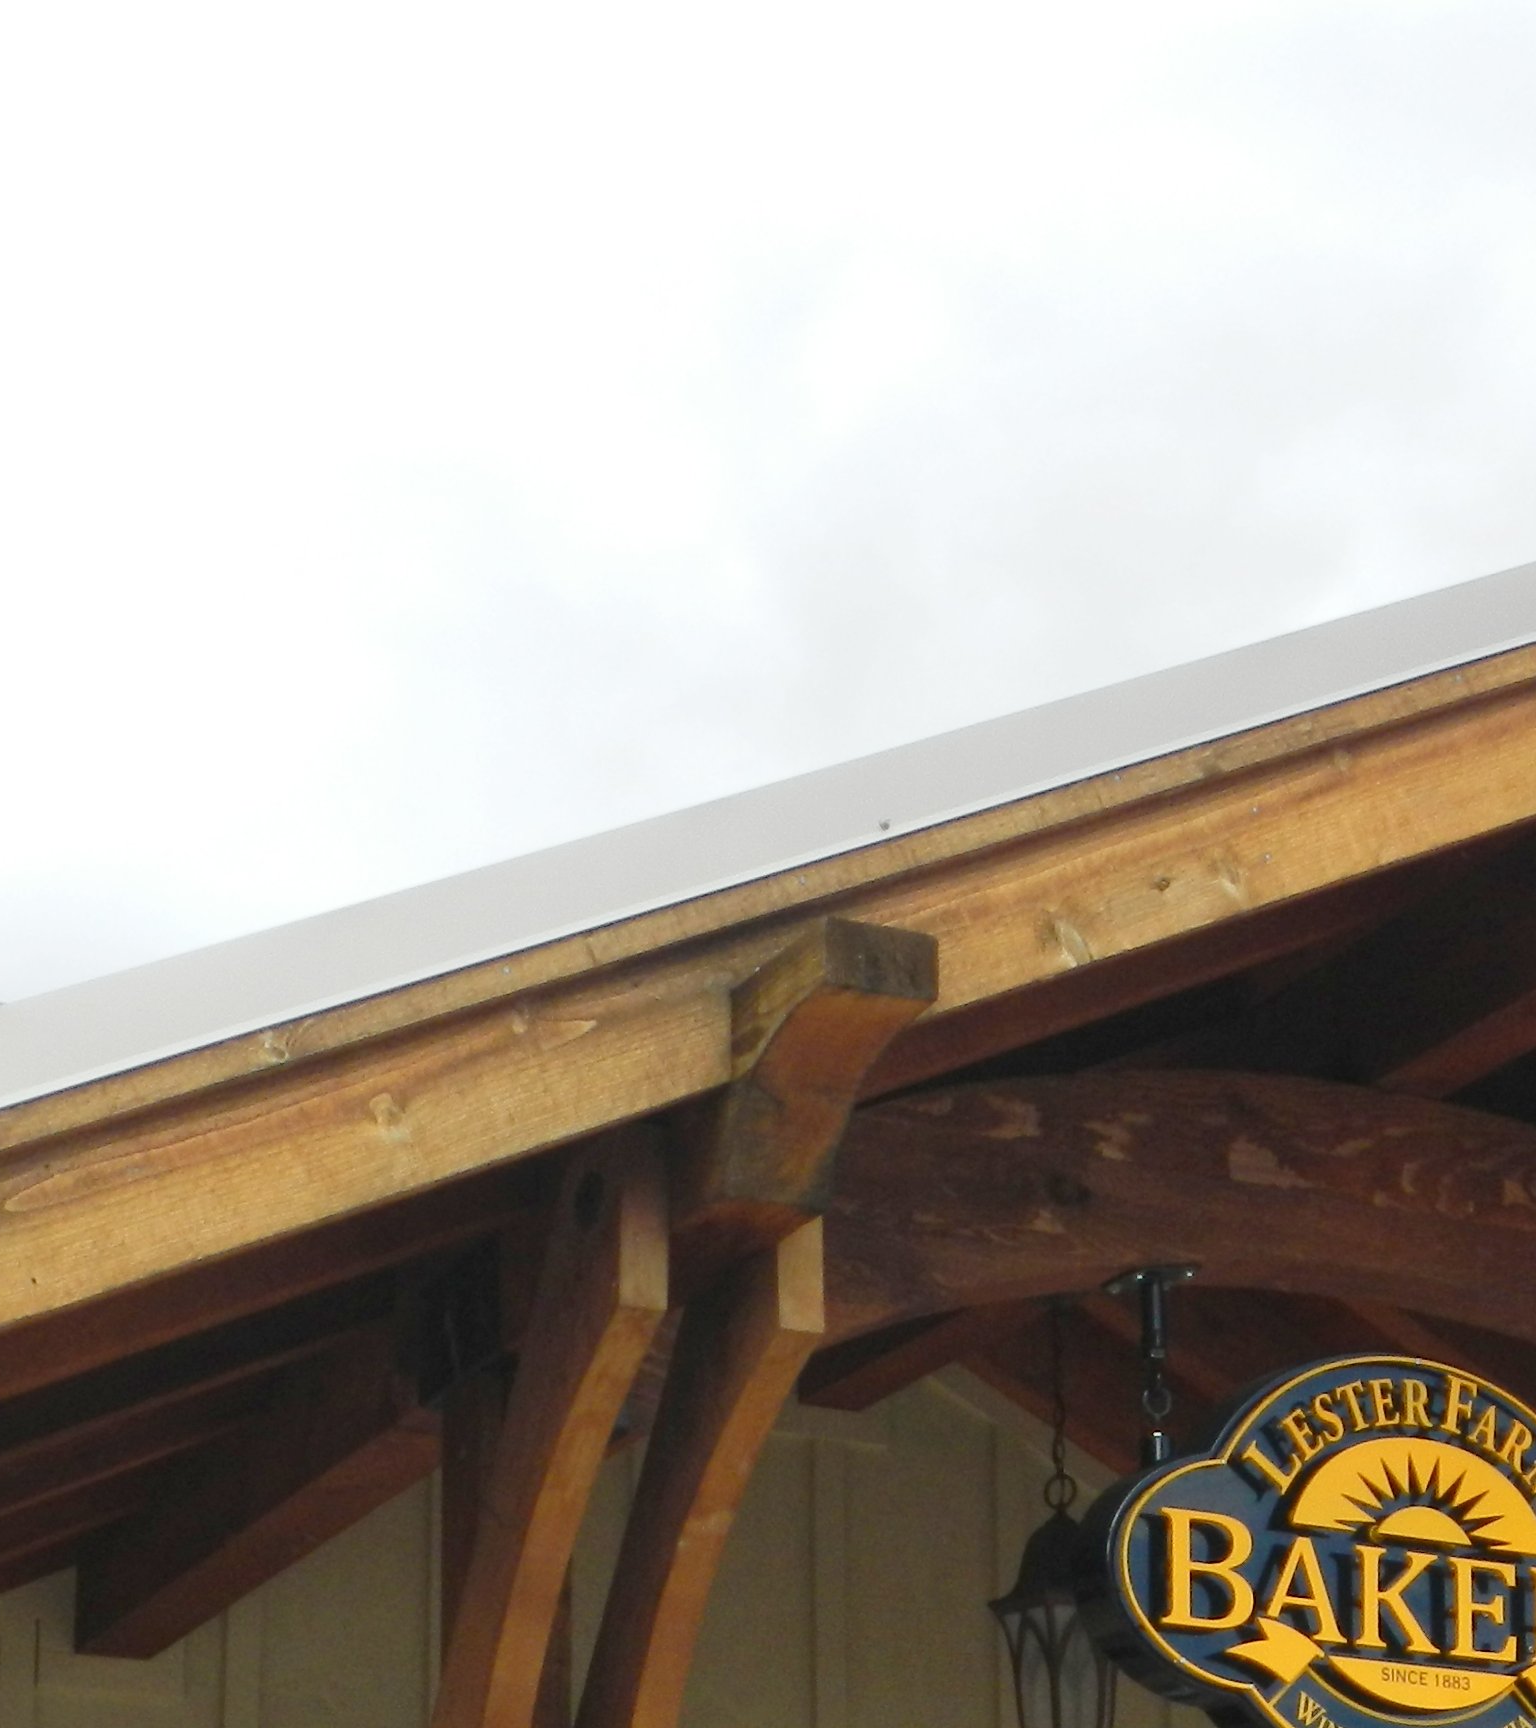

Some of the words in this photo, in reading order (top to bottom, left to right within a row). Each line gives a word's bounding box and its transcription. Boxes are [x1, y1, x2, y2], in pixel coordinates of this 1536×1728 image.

[1243, 1378, 1433, 1493] LESTER
[1380, 1668, 1429, 1688] SINCE
[1434, 1674, 1472, 1691] 1883
